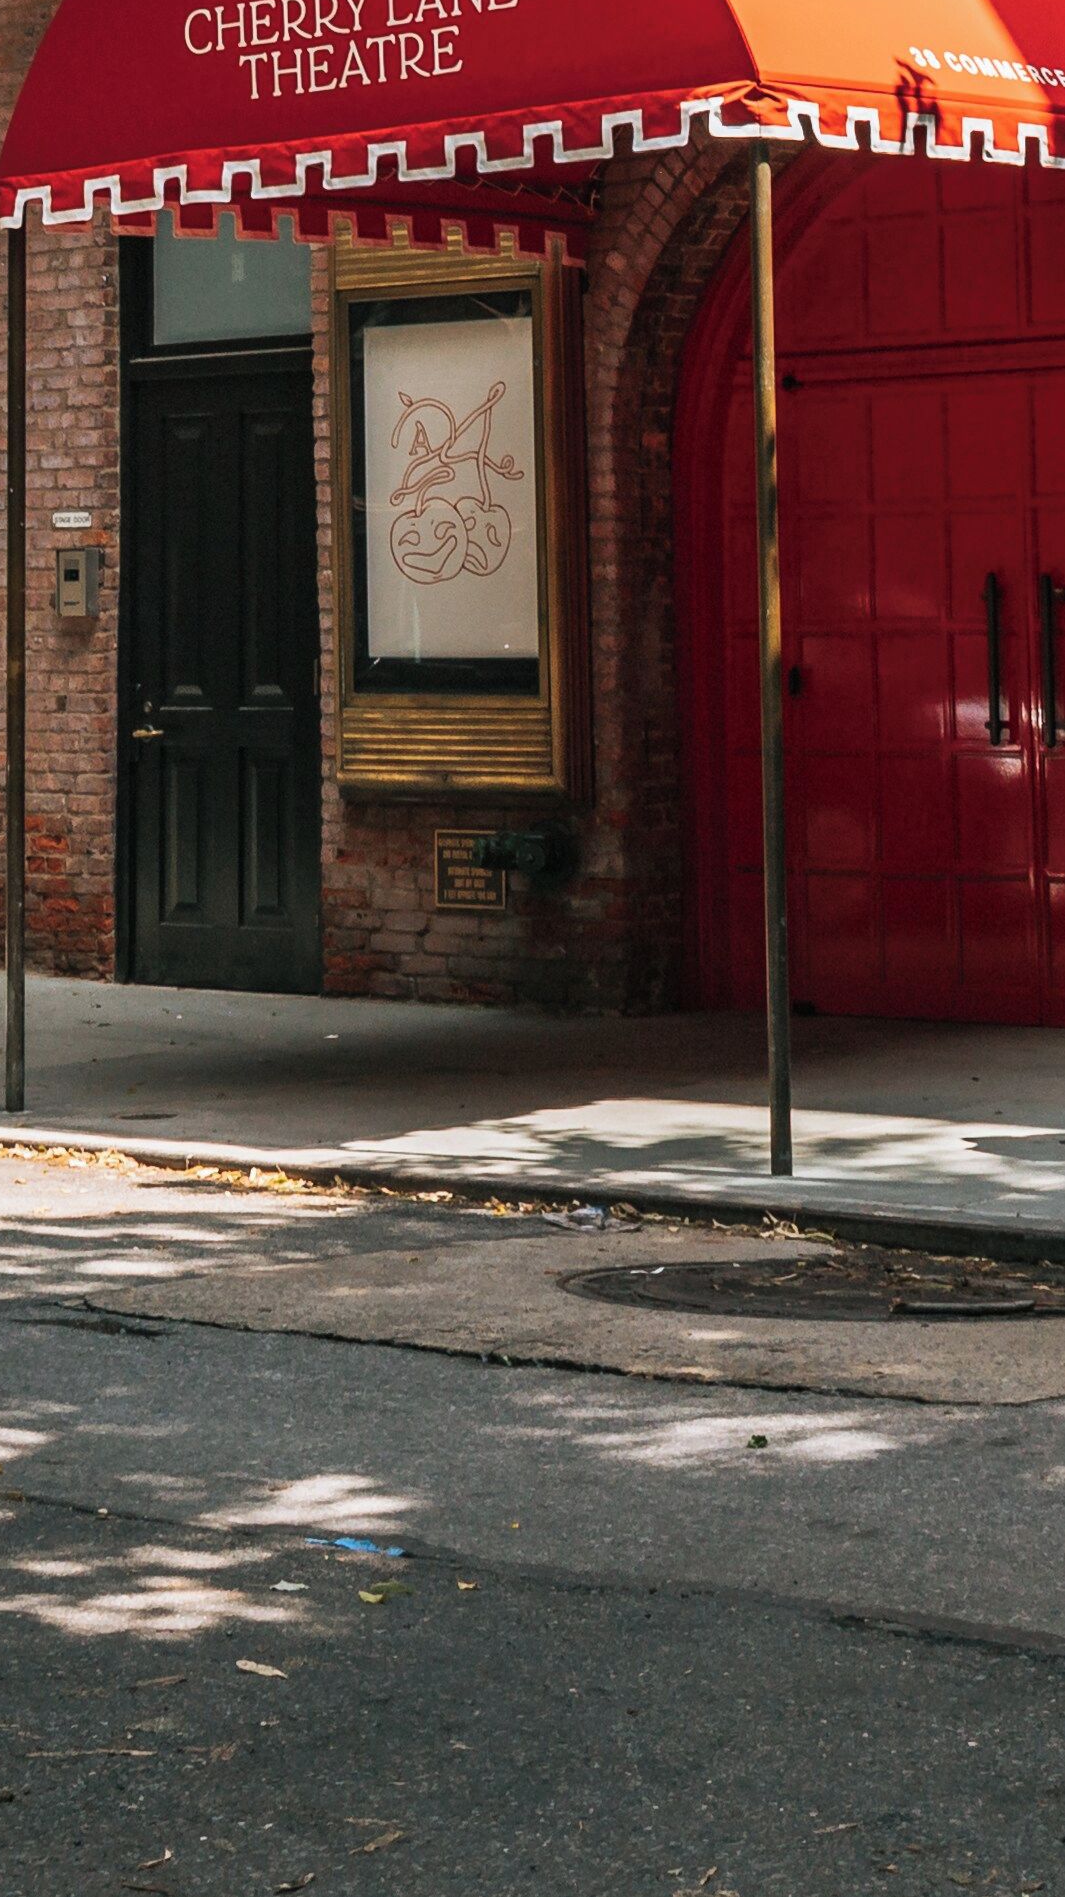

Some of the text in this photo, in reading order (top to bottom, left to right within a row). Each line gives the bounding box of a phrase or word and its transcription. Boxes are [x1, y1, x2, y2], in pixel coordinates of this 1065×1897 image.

[238, 24, 464, 100] THEATRE
[909, 46, 1065, 88] 38 COMMERCE
